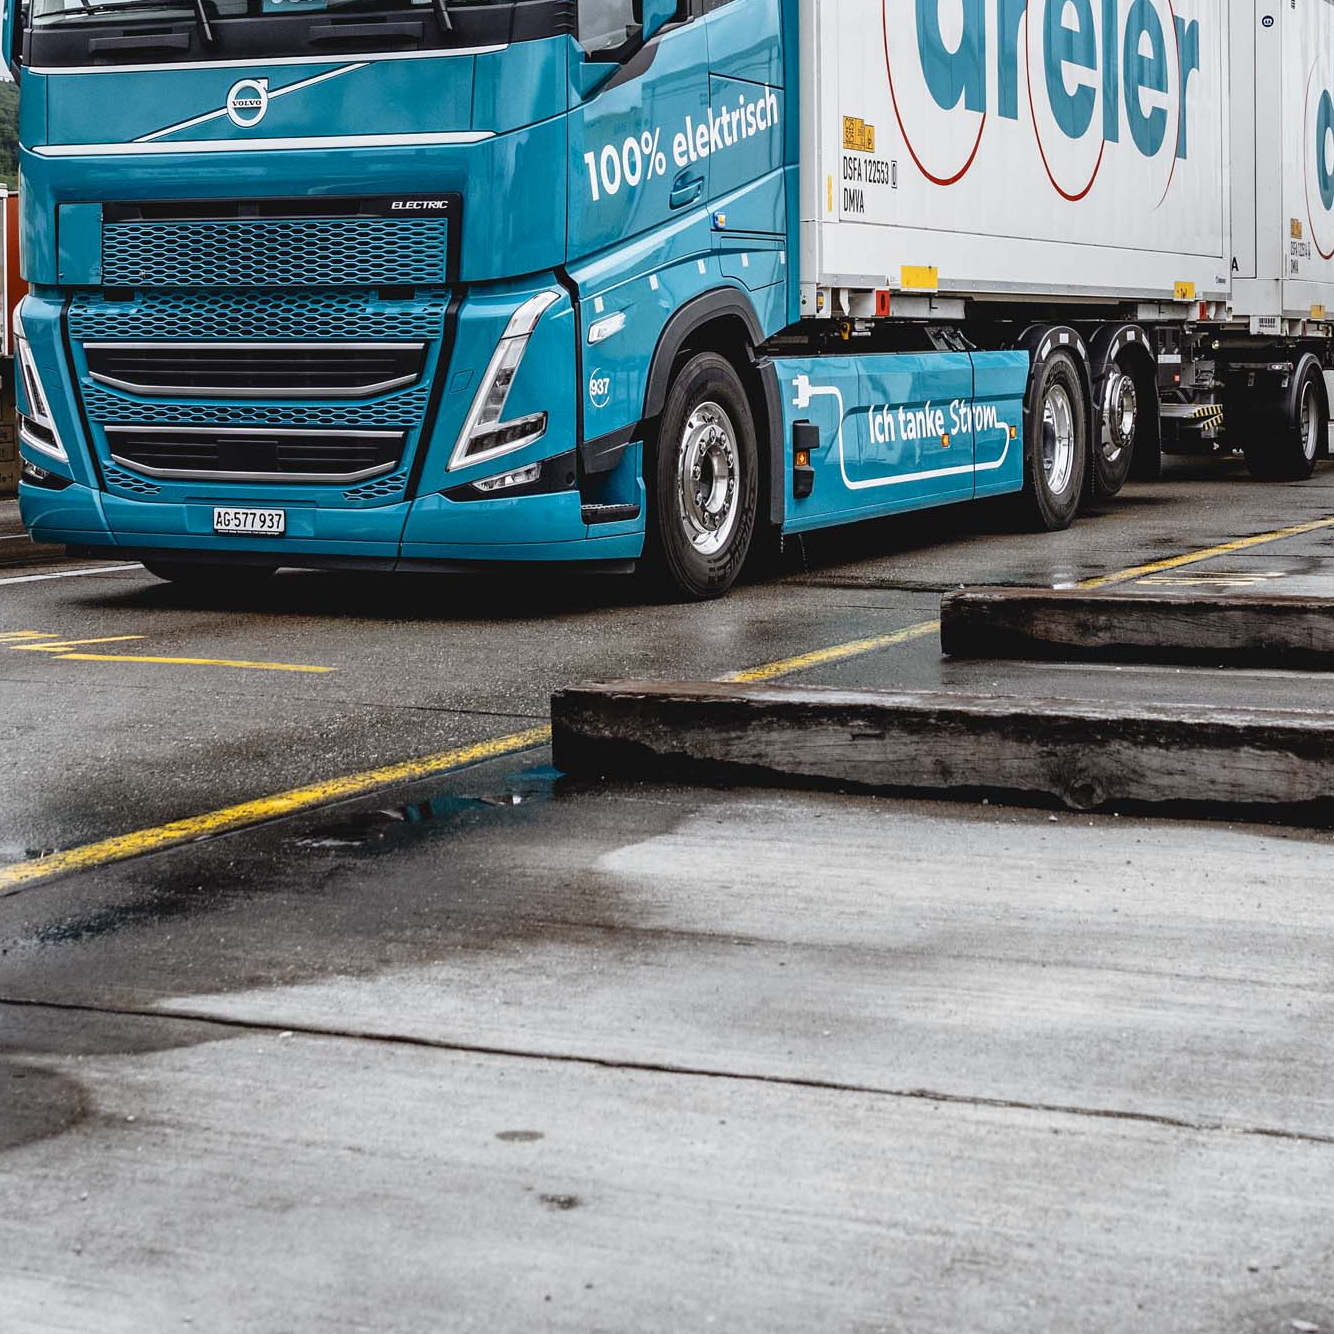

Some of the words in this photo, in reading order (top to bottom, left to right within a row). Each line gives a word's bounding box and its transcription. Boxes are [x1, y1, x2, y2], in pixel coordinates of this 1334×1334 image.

[231, 99, 262, 107] VOLVO
[583, 126, 667, 202] 100%
[672, 84, 778, 168] elektrisch
[843, 155, 863, 182] DSFA
[864, 158, 890, 185] 122553
[391, 200, 449, 210] ELECTRIC
[843, 187, 865, 214] DMVA
[590, 377, 610, 396] 937
[868, 403, 896, 444] Ich
[898, 400, 945, 441] tanke
[949, 399, 998, 436] Strom
